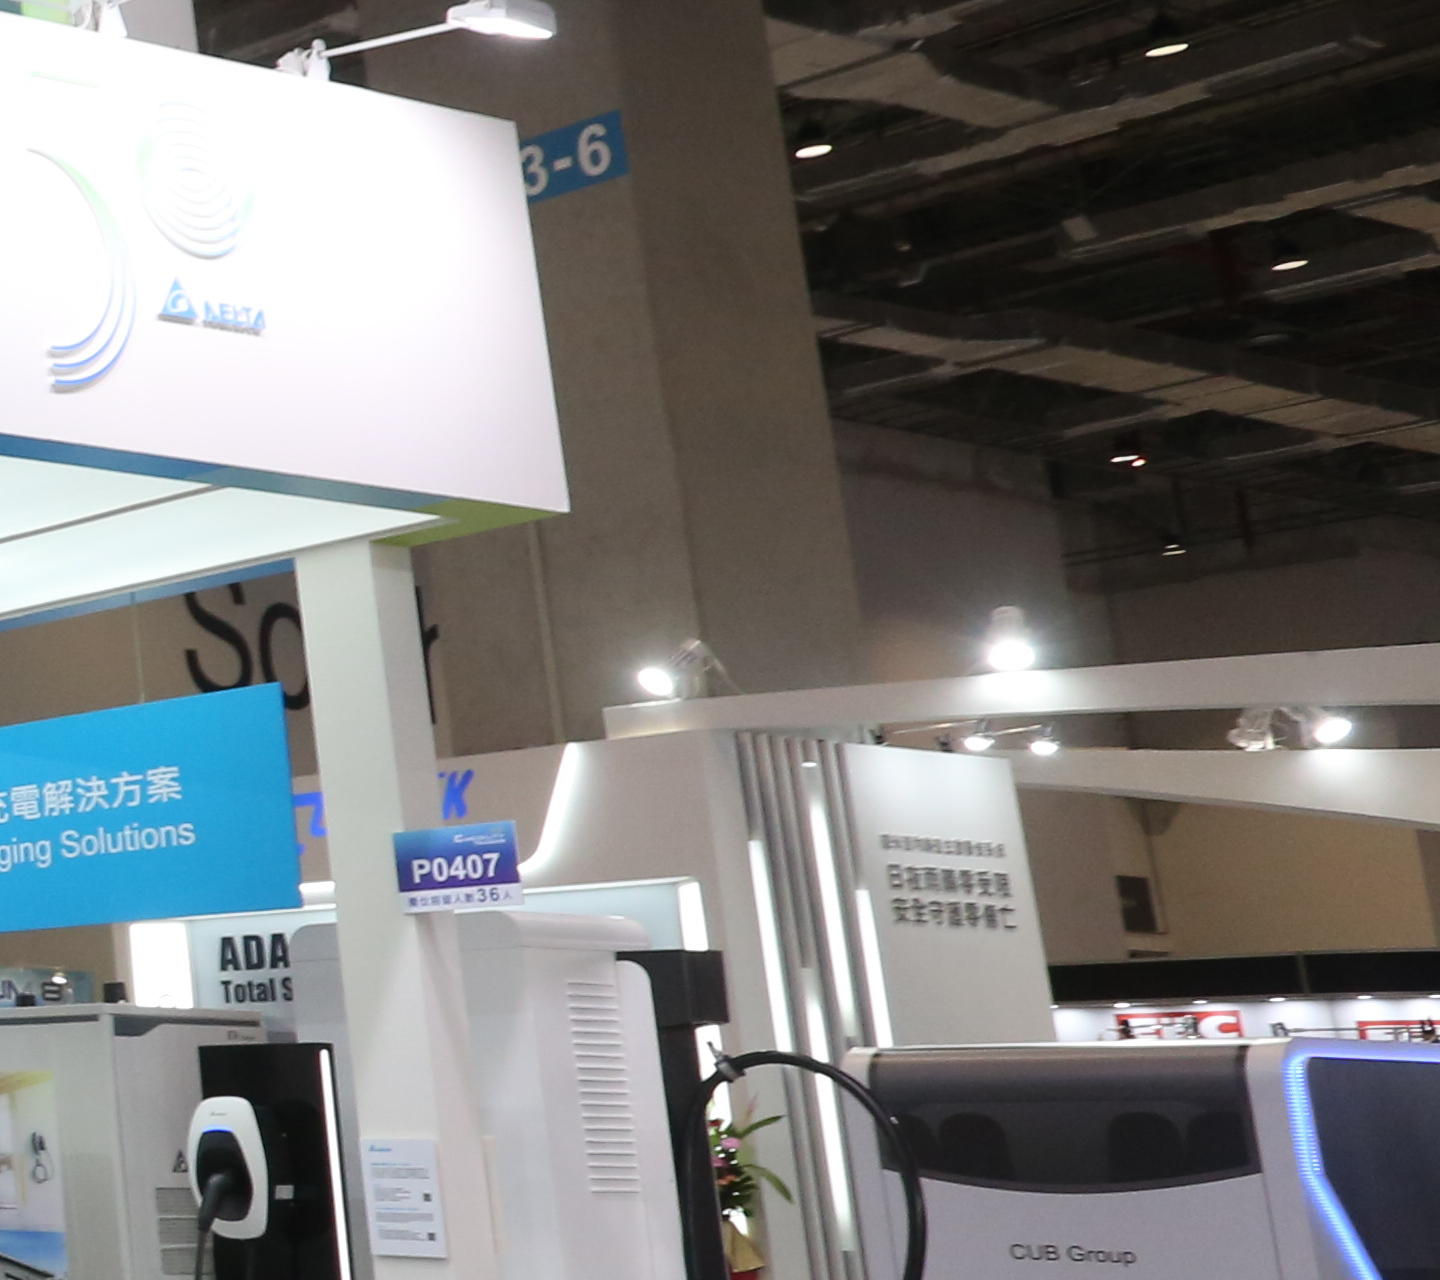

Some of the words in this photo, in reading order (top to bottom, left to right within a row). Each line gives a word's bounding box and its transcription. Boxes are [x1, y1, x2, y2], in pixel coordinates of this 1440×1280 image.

[60, 819, 197, 859] Solutions
[410, 852, 501, 885] P0407
[476, 887, 500, 903] 36
[220, 932, 291, 972] ADA
[221, 977, 276, 1004] Total
[1009, 1243, 1060, 1261] CUB
[1066, 1245, 1137, 1267] Group
